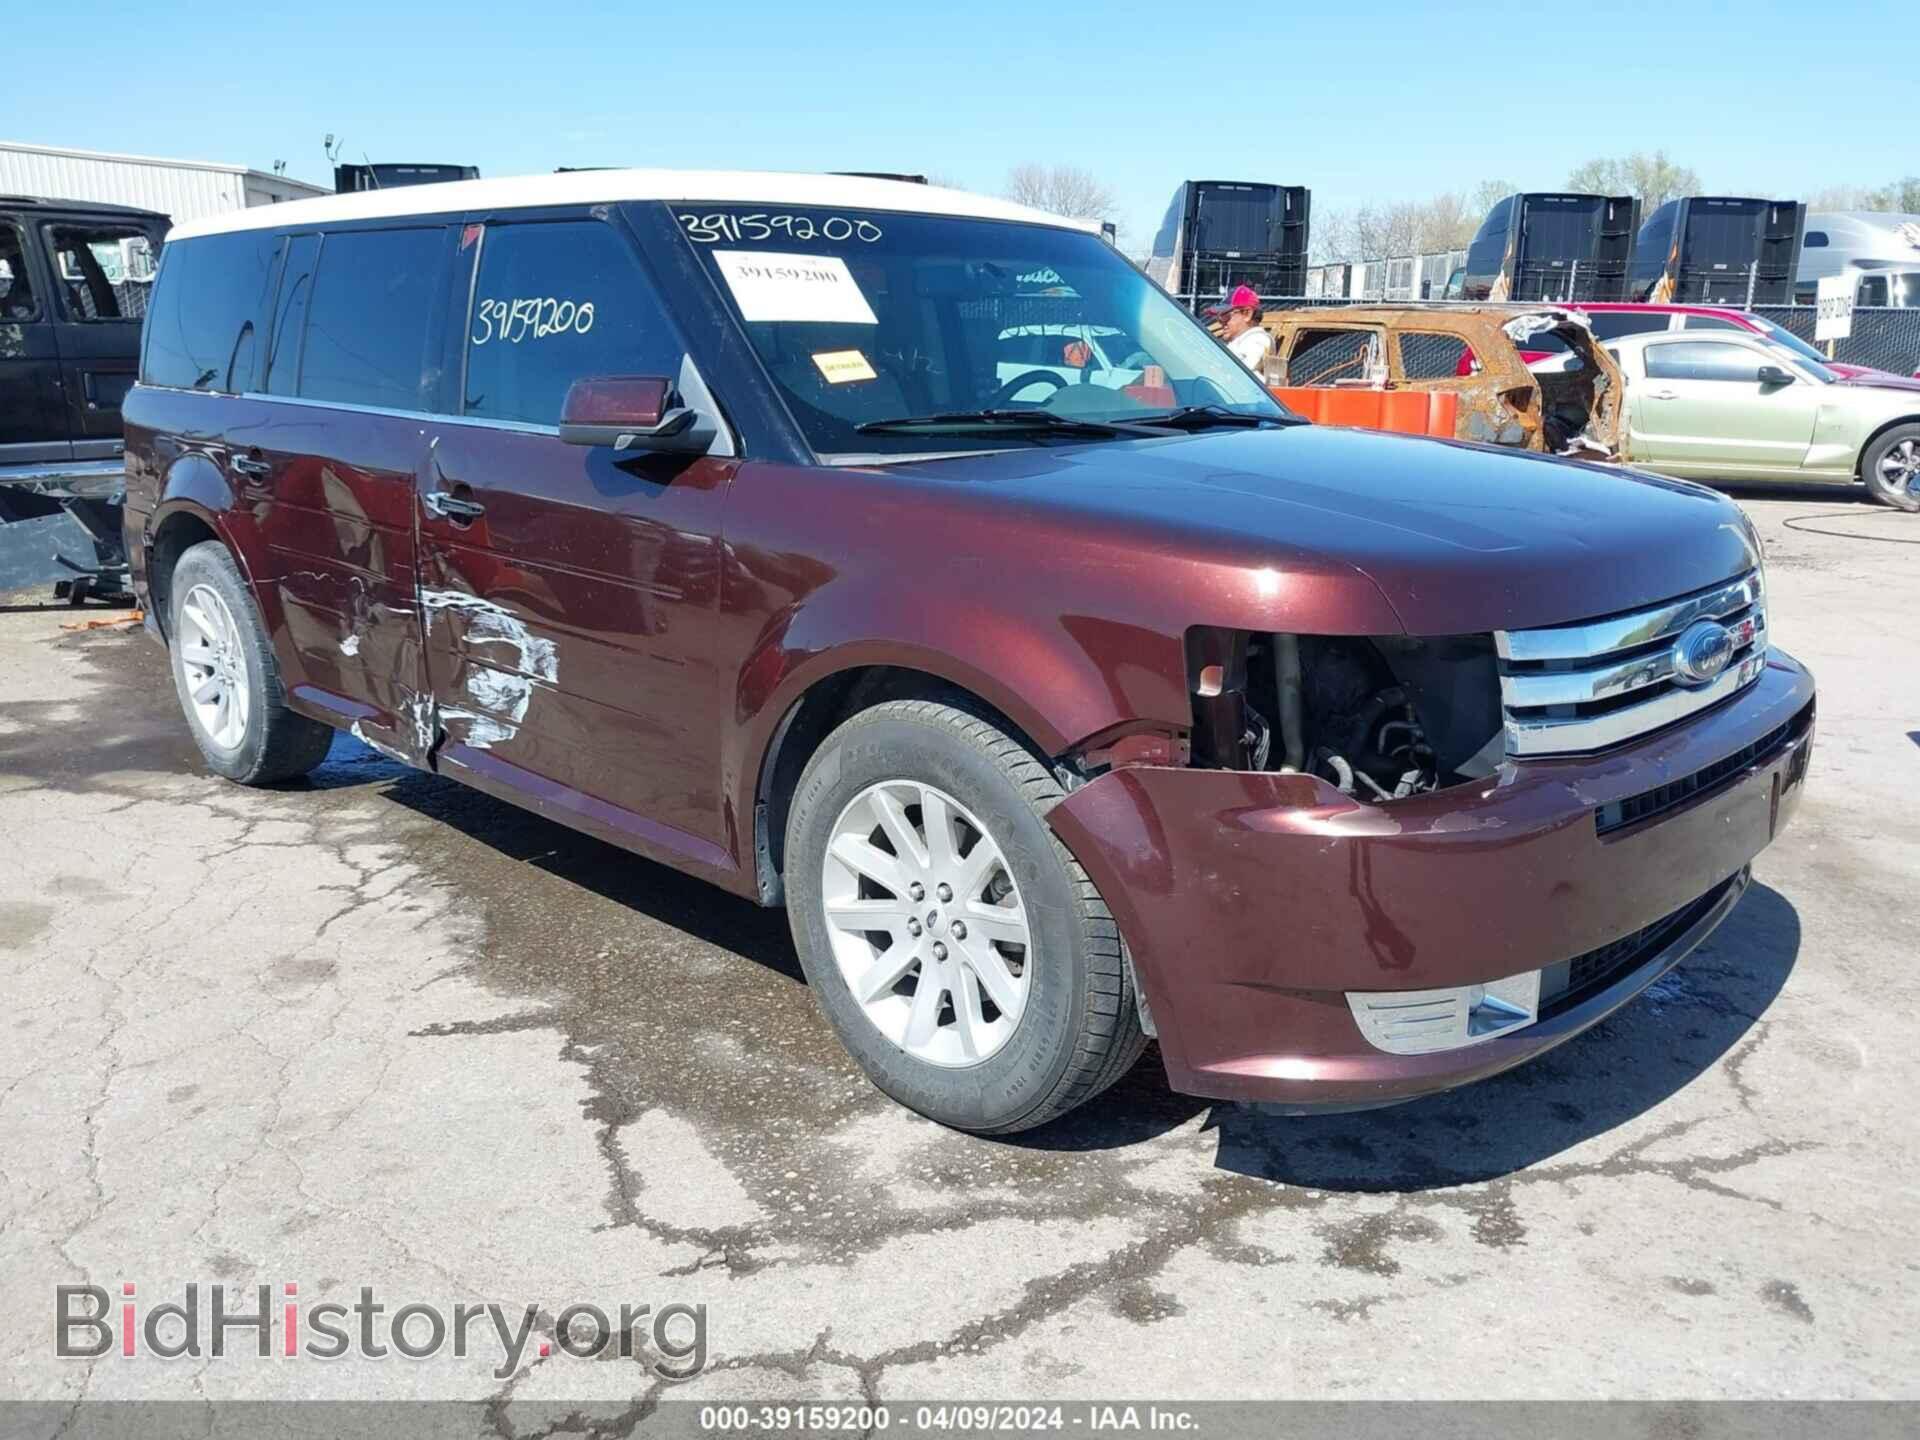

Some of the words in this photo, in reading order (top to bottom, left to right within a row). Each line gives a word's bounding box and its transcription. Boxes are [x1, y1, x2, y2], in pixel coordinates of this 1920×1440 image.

[679, 213, 883, 242] 39159200
[737, 265, 838, 283] 39159200
[472, 297, 595, 345] 39159200
